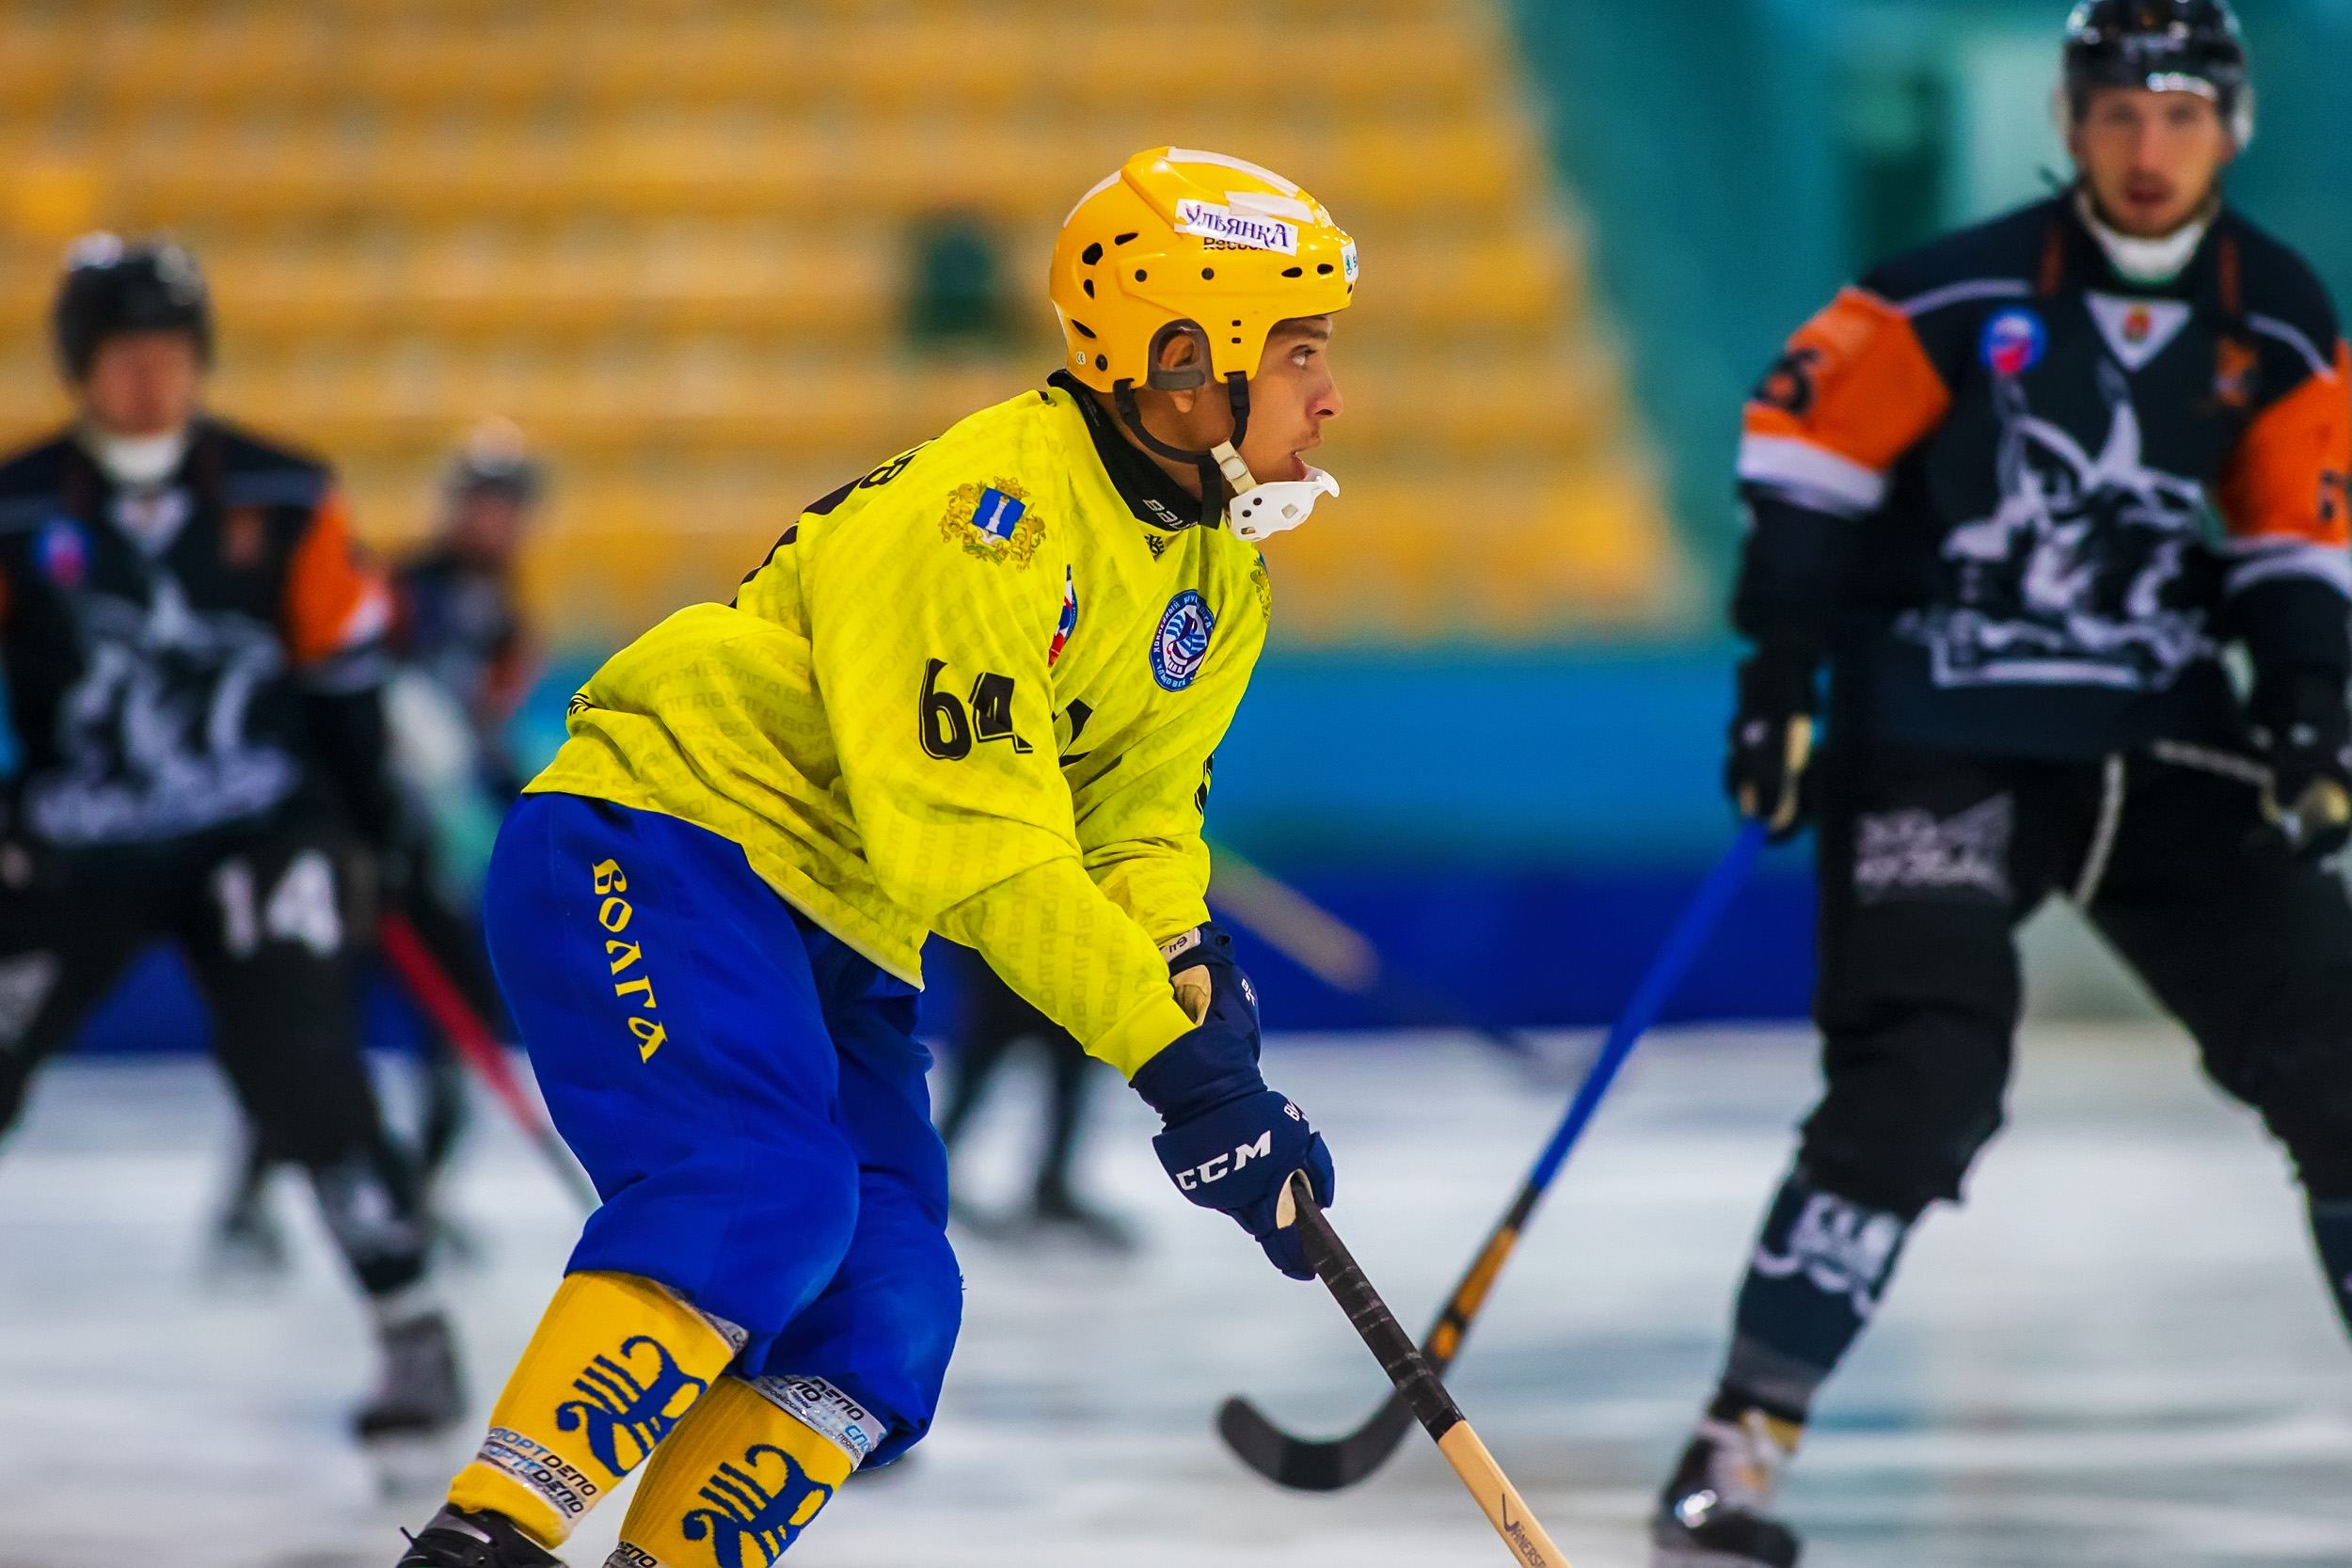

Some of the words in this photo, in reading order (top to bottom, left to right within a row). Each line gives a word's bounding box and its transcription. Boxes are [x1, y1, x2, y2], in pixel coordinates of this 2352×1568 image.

[918, 657, 1034, 761] 64
[213, 851, 344, 956] 14
[592, 858, 669, 1065] ВОЛГА
[1175, 1130, 1271, 1191] CCM
